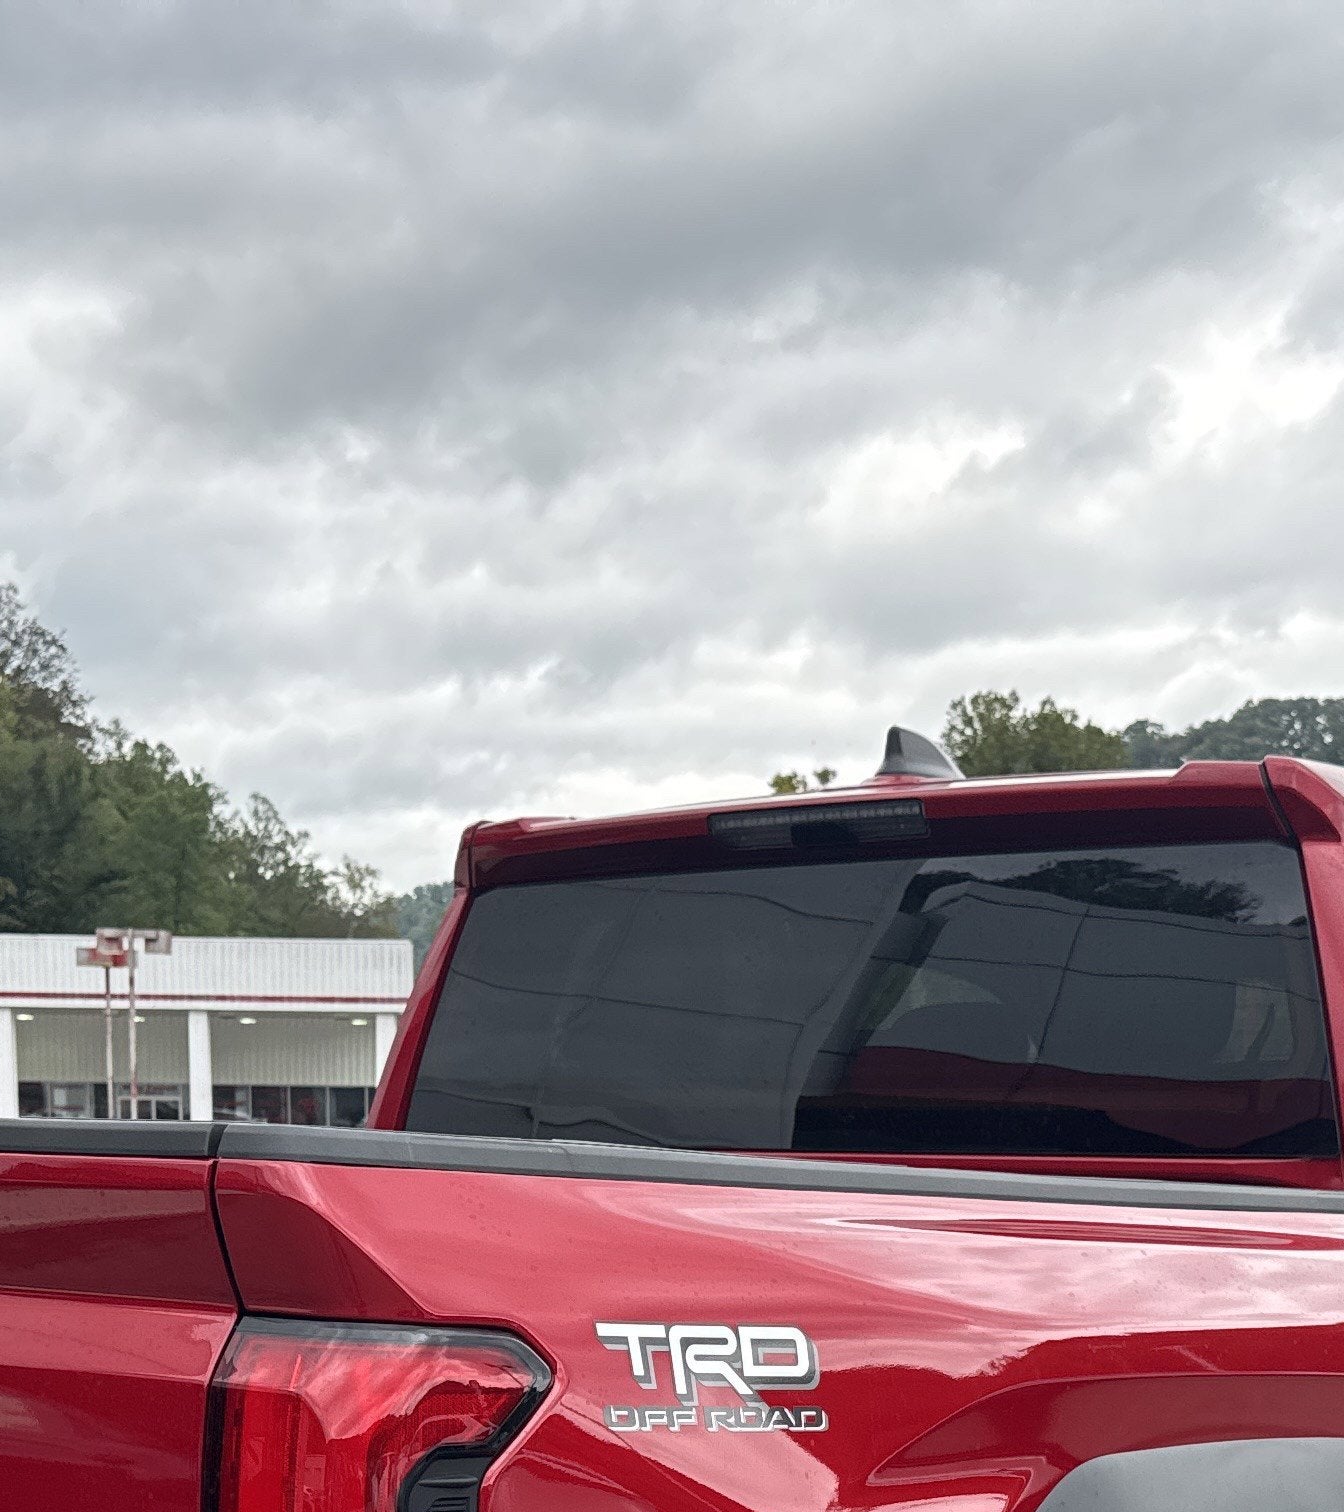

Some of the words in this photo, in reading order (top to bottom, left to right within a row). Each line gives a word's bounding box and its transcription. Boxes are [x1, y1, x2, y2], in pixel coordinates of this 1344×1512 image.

[595, 1321, 820, 1406] TRD
[603, 1404, 697, 1432] OFF
[703, 1404, 828, 1432] ROAD
